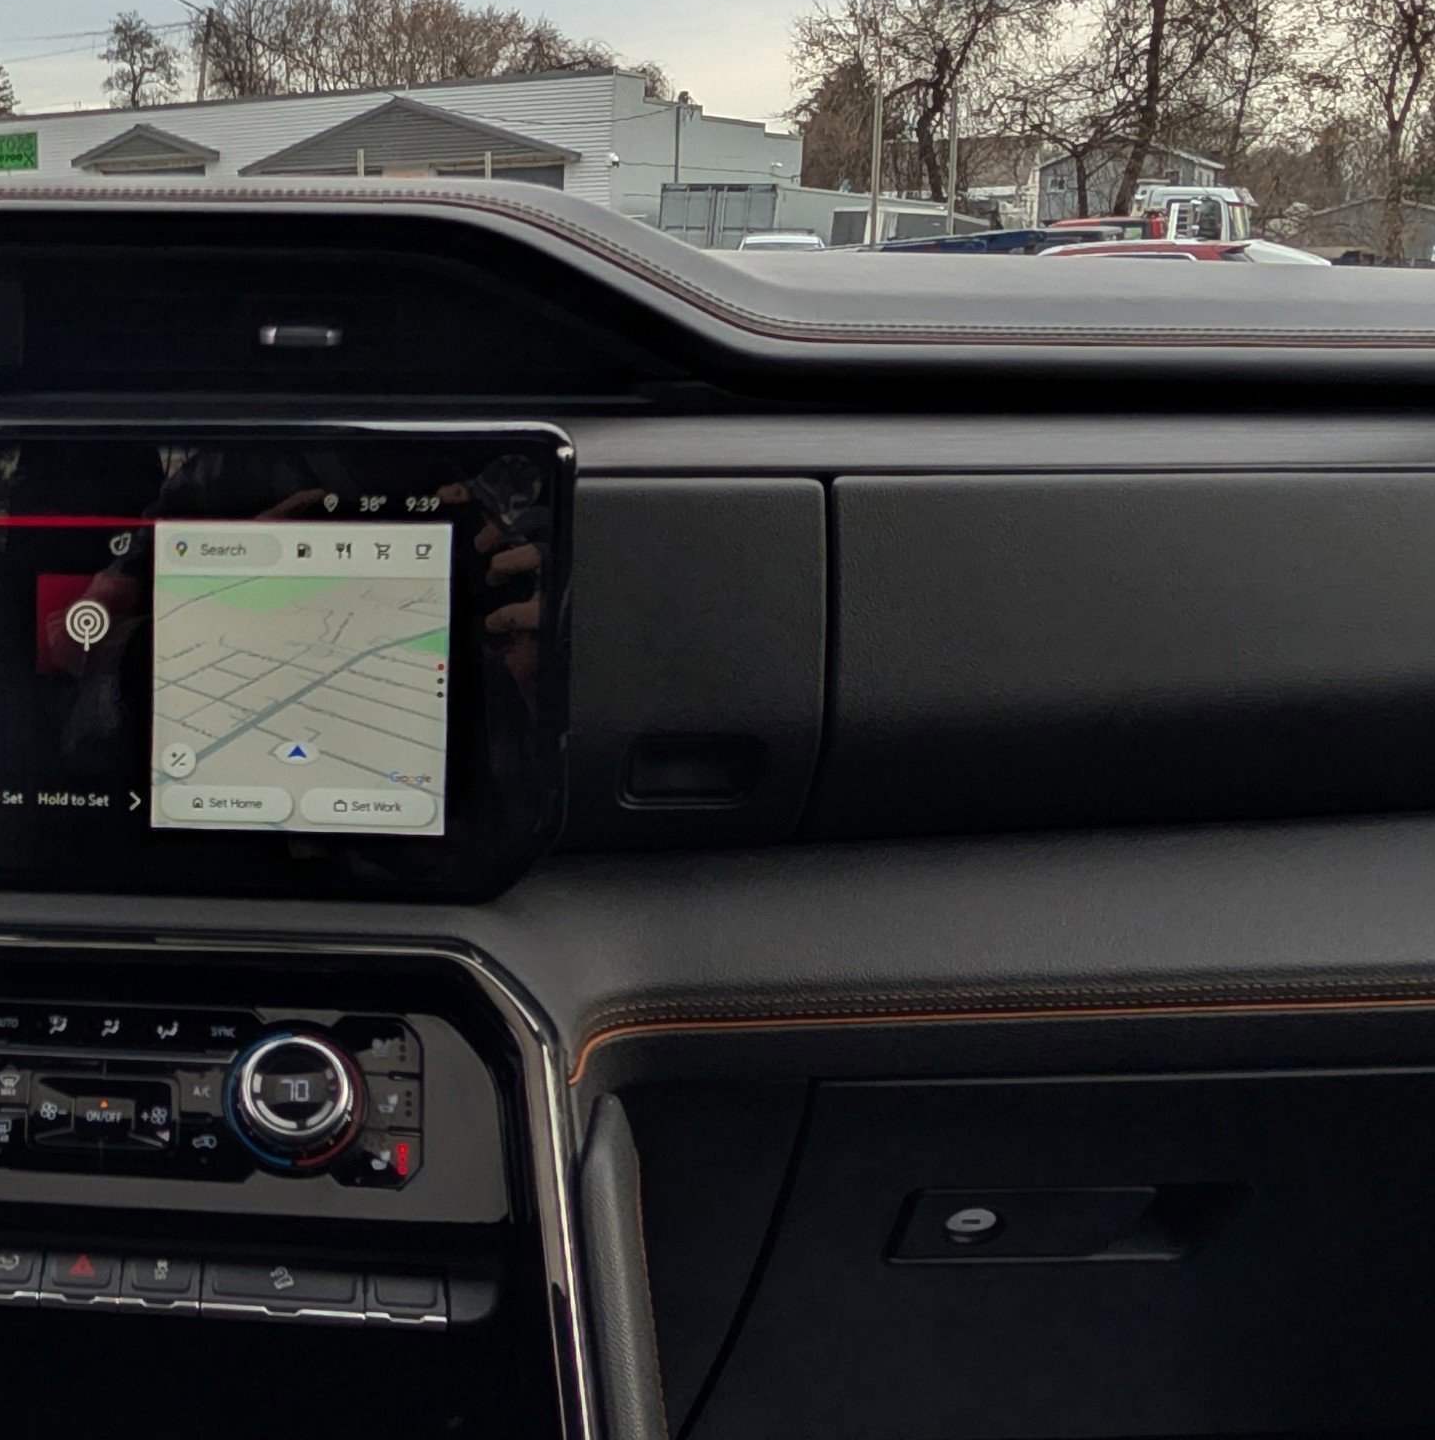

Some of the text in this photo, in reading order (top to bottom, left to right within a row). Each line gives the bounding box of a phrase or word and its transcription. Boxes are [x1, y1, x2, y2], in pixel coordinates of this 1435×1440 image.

[200, 543, 247, 557] Search
[390, 771, 431, 786] Google
[3, 790, 23, 804] Set
[38, 792, 109, 807] Hold to Set
[209, 798, 263, 809] Set Home
[352, 801, 402, 813] Set Work
[193, 1086, 211, 1098] A/C
[280, 1079, 310, 1102] 70
[86, 1111, 122, 1124] ON/OFF
